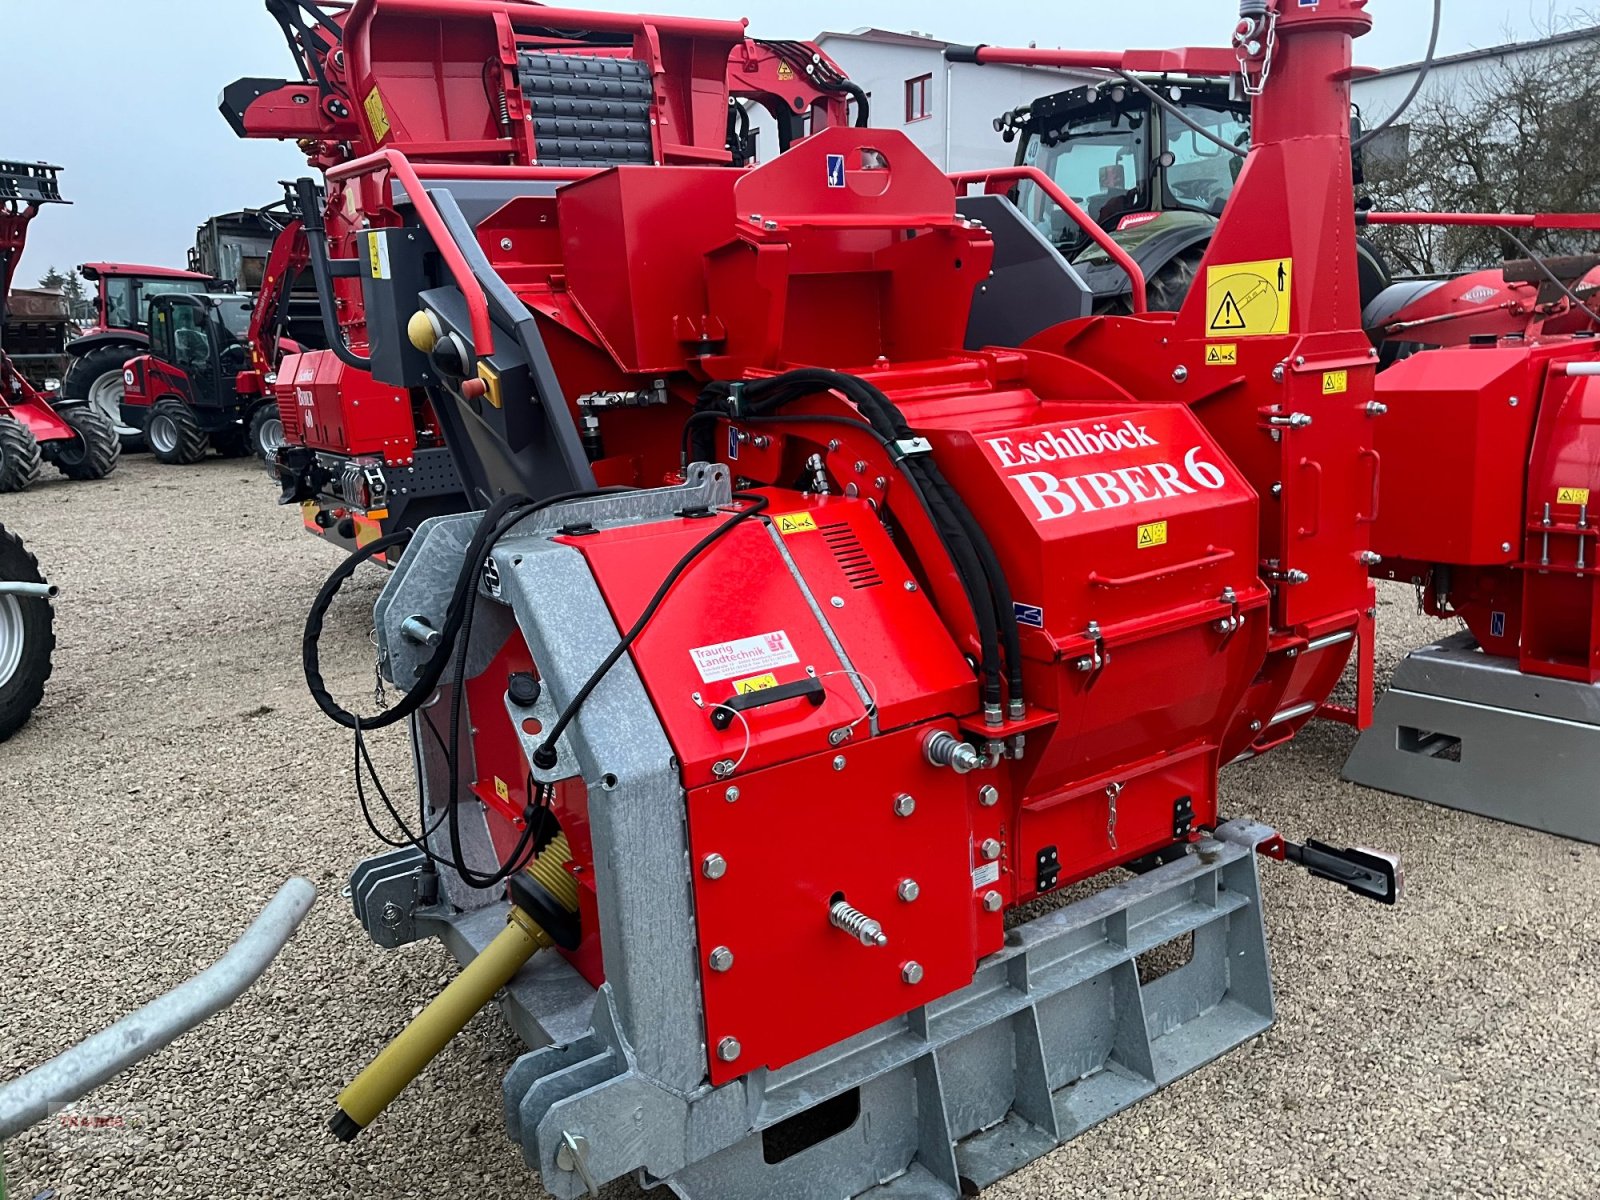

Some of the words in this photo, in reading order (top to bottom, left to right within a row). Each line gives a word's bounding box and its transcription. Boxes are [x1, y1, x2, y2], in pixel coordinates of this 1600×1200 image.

[1465, 288, 1494, 300] KUHN
[984, 419, 1160, 468] Eschlböck
[1008, 461, 1198, 522] BIBER
[1183, 445, 1226, 490] 6
[694, 644, 734, 659] Traurig
[699, 646, 765, 668] Landtechnik
